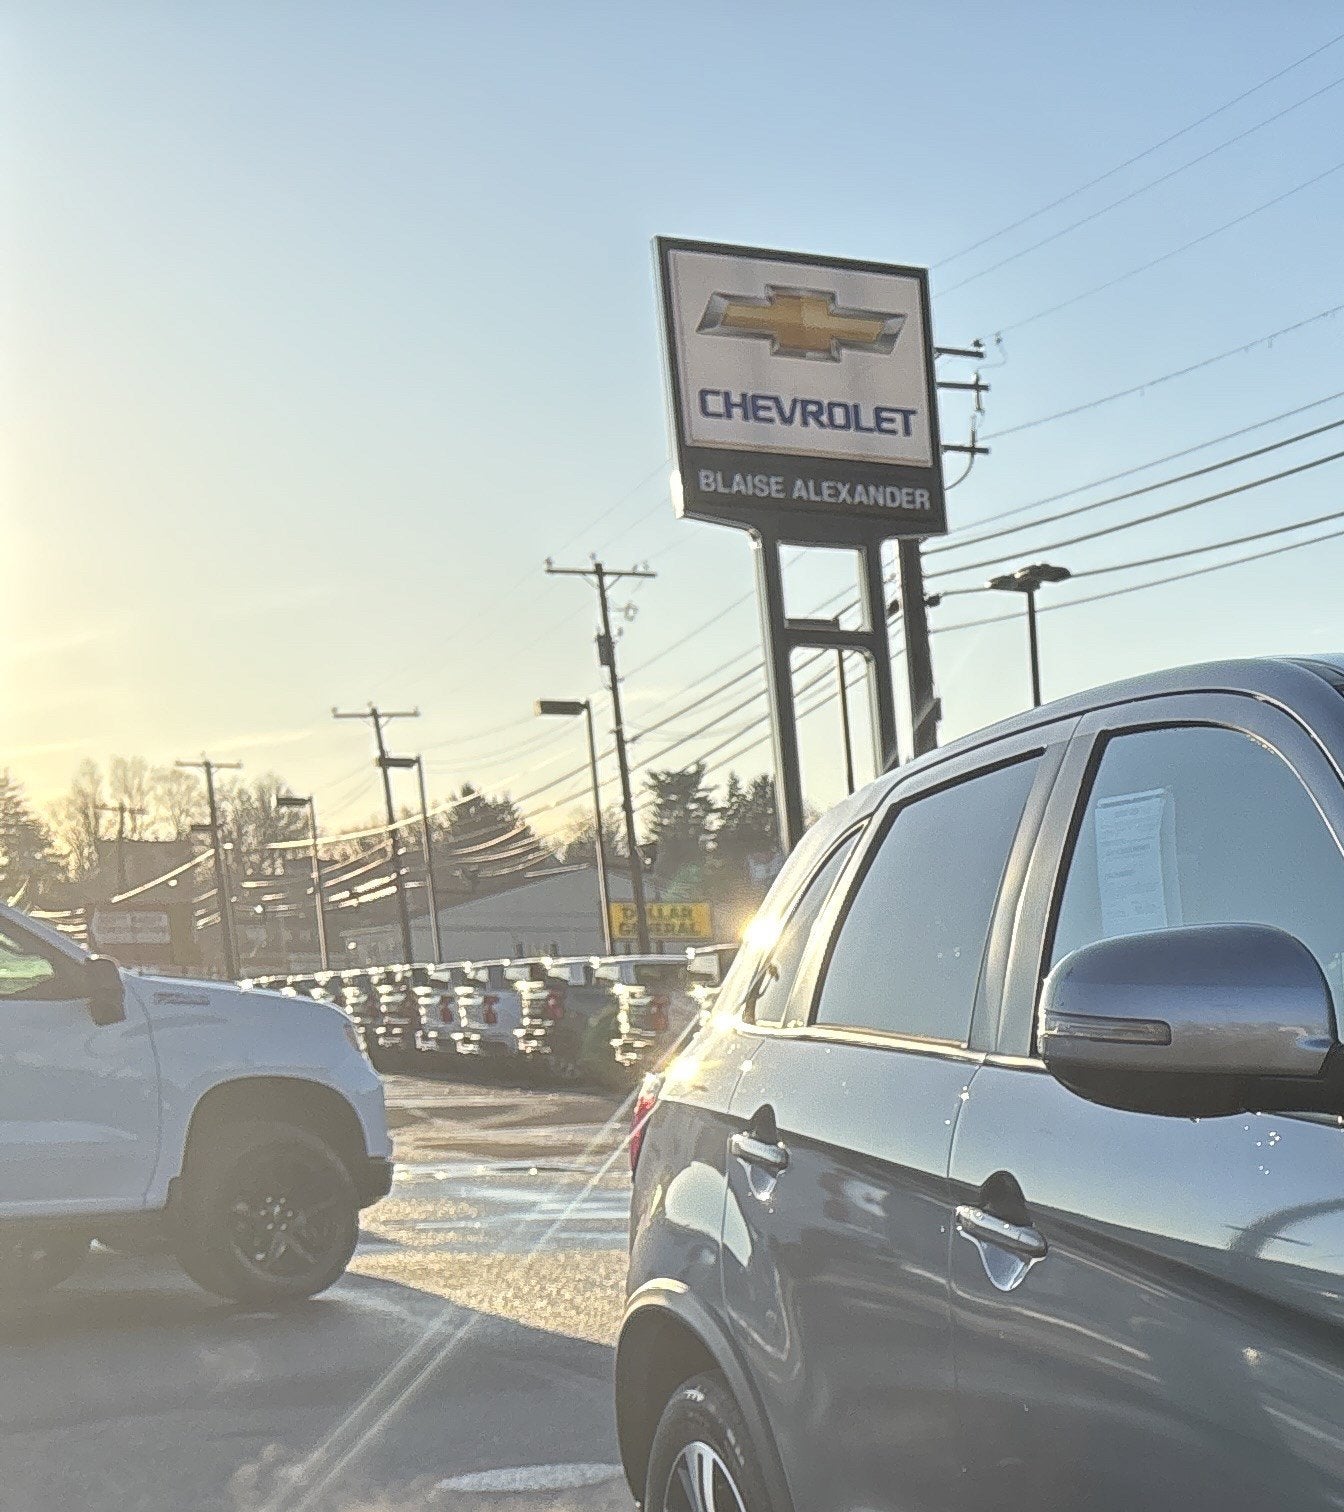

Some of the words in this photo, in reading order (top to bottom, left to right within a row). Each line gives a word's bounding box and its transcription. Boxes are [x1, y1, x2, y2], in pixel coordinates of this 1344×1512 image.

[698, 389, 917, 437] CHEVROLET
[699, 469, 786, 499] BLAISE
[793, 478, 930, 510] ALEXANDER
[621, 905, 693, 920] DLLAR
